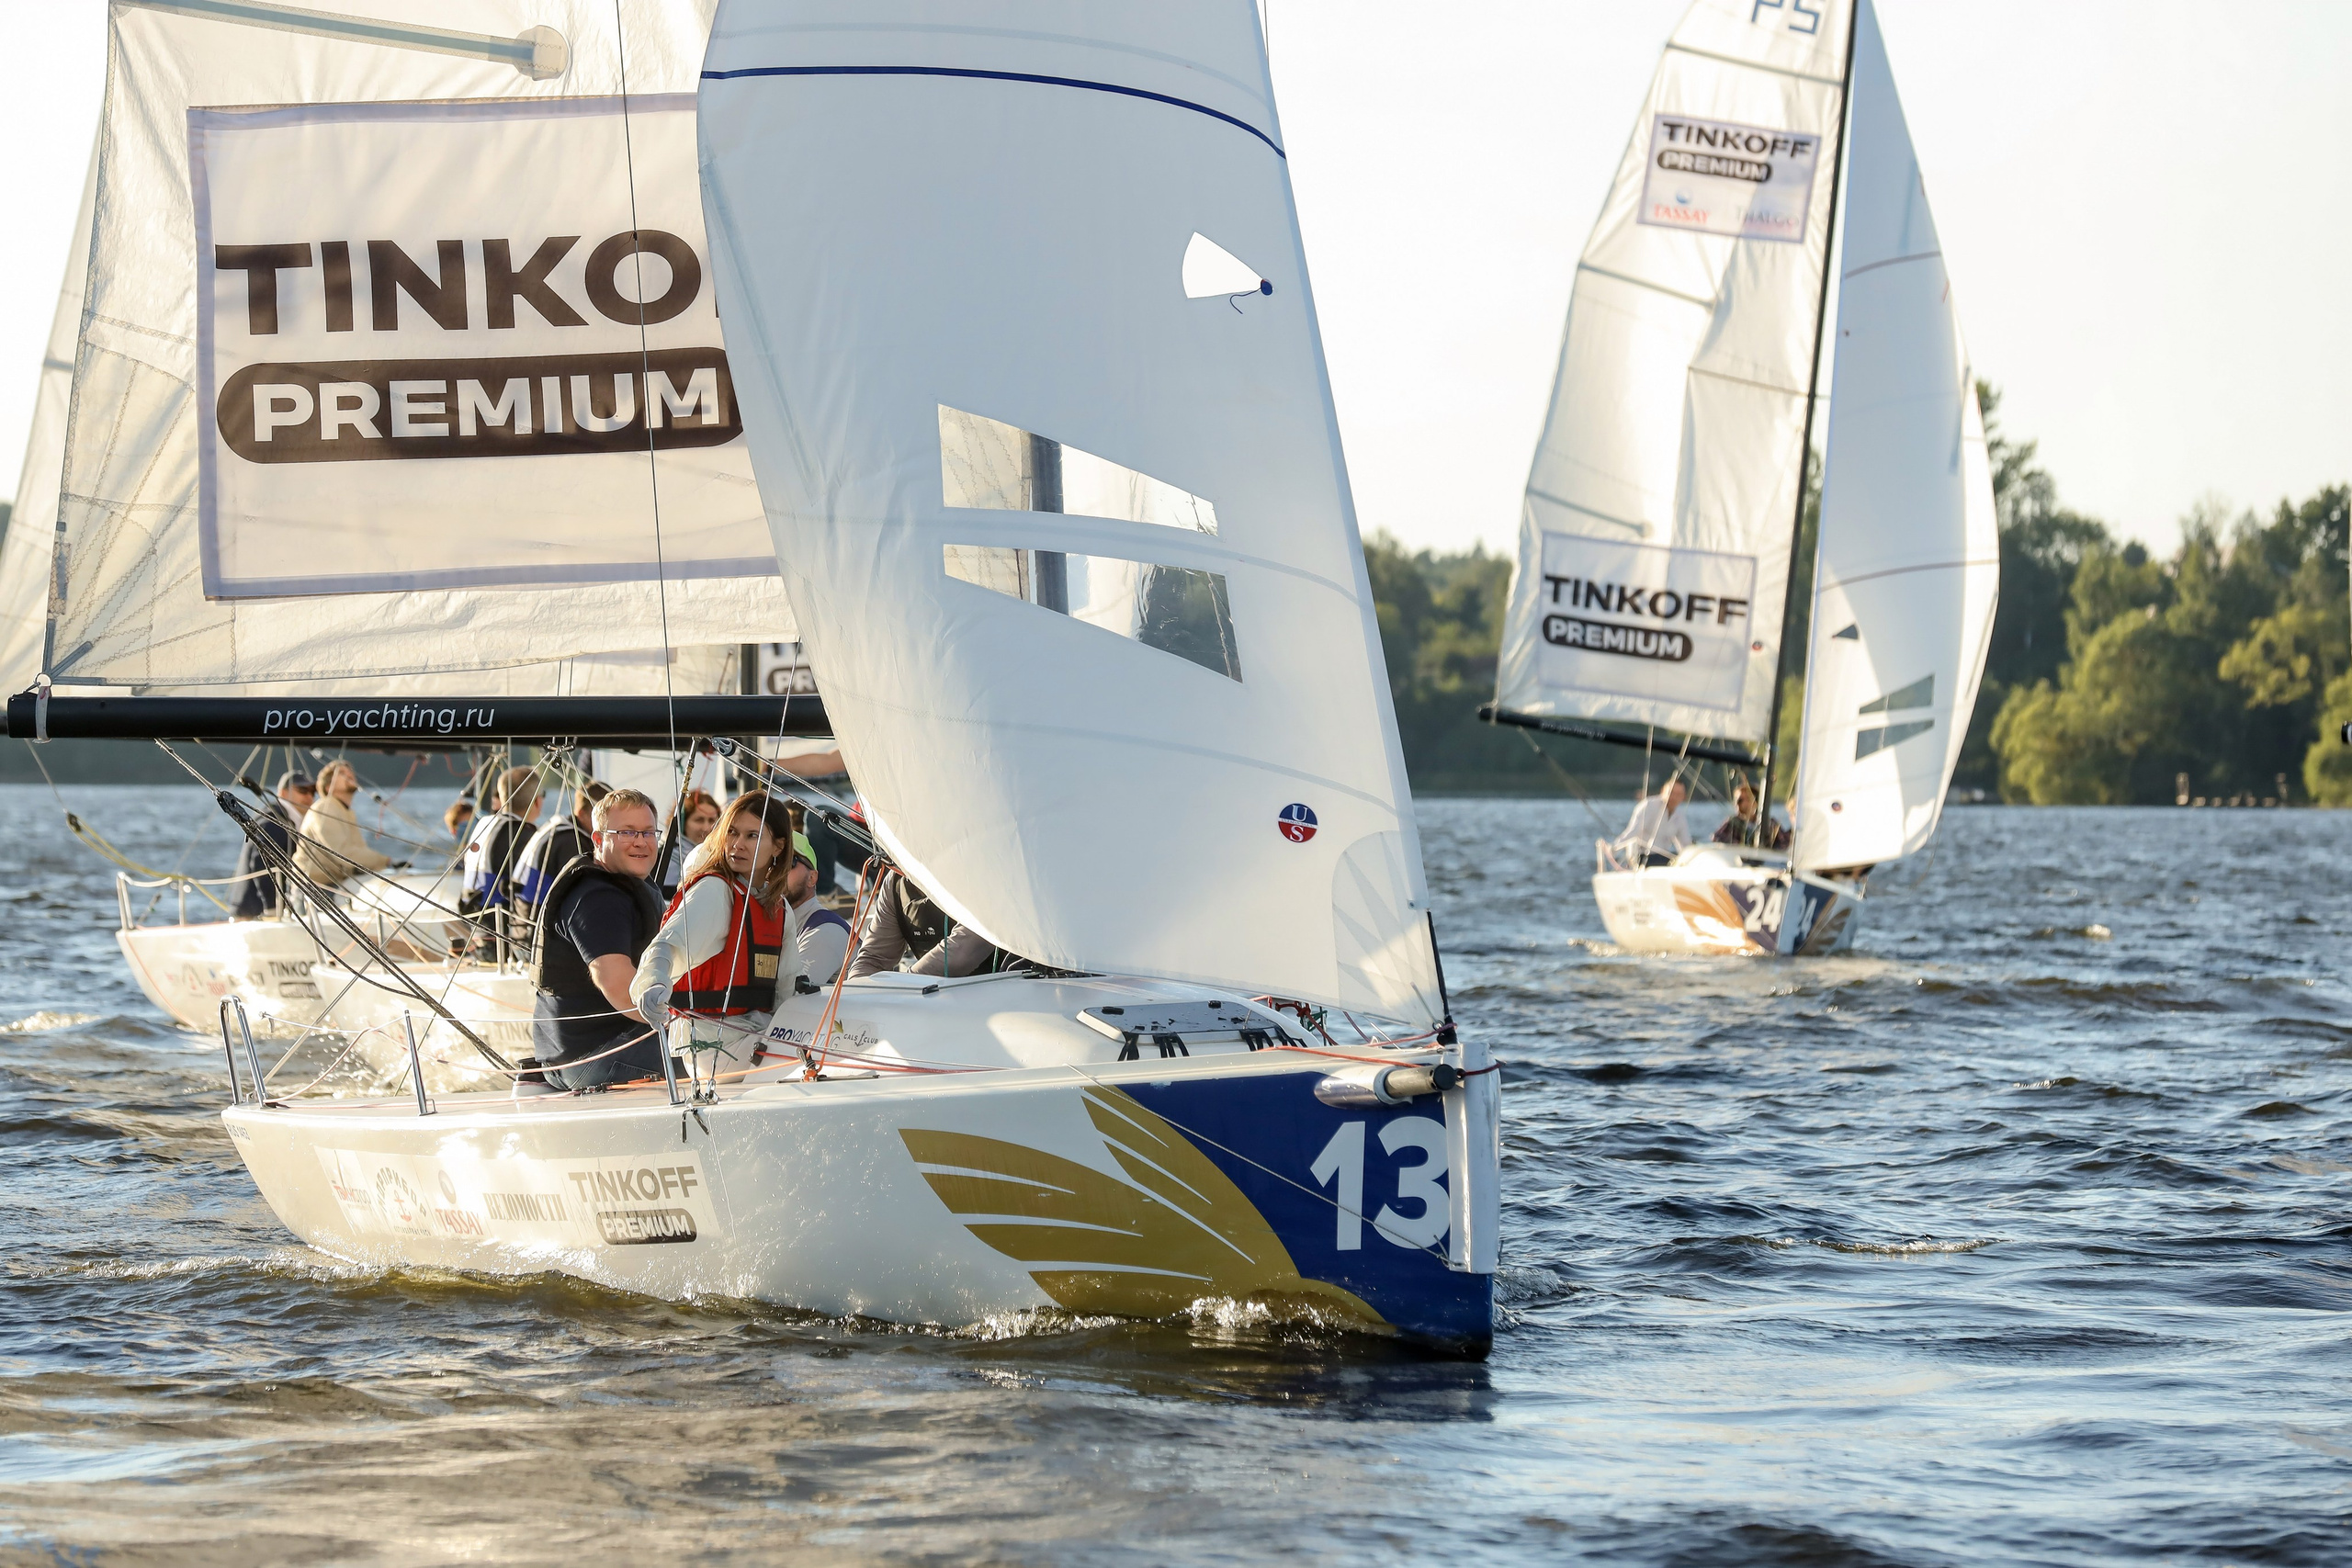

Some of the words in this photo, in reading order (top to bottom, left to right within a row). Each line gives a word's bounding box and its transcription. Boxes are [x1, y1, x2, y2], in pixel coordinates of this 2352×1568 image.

[1663, 121, 1813, 159] TINKOFF
[1663, 152, 1769, 181] PREMIUM
[1654, 203, 1711, 224] TASSAY
[215, 229, 719, 335] TINKO
[251, 367, 721, 443] PREMIUM
[1544, 573, 1748, 625] TINKOFF
[1548, 617, 1685, 660] PREMIUM
[263, 703, 495, 734] pro-yachting.ru
[1746, 886, 1782, 933] 24
[568, 1166, 698, 1203] TINKOFF
[1309, 1115, 1451, 1251] 13
[435, 1208, 484, 1235] TASSAY
[482, 1192, 569, 1223] ВЕДОМОСТИ
[601, 1214, 692, 1240] PREMIUM
